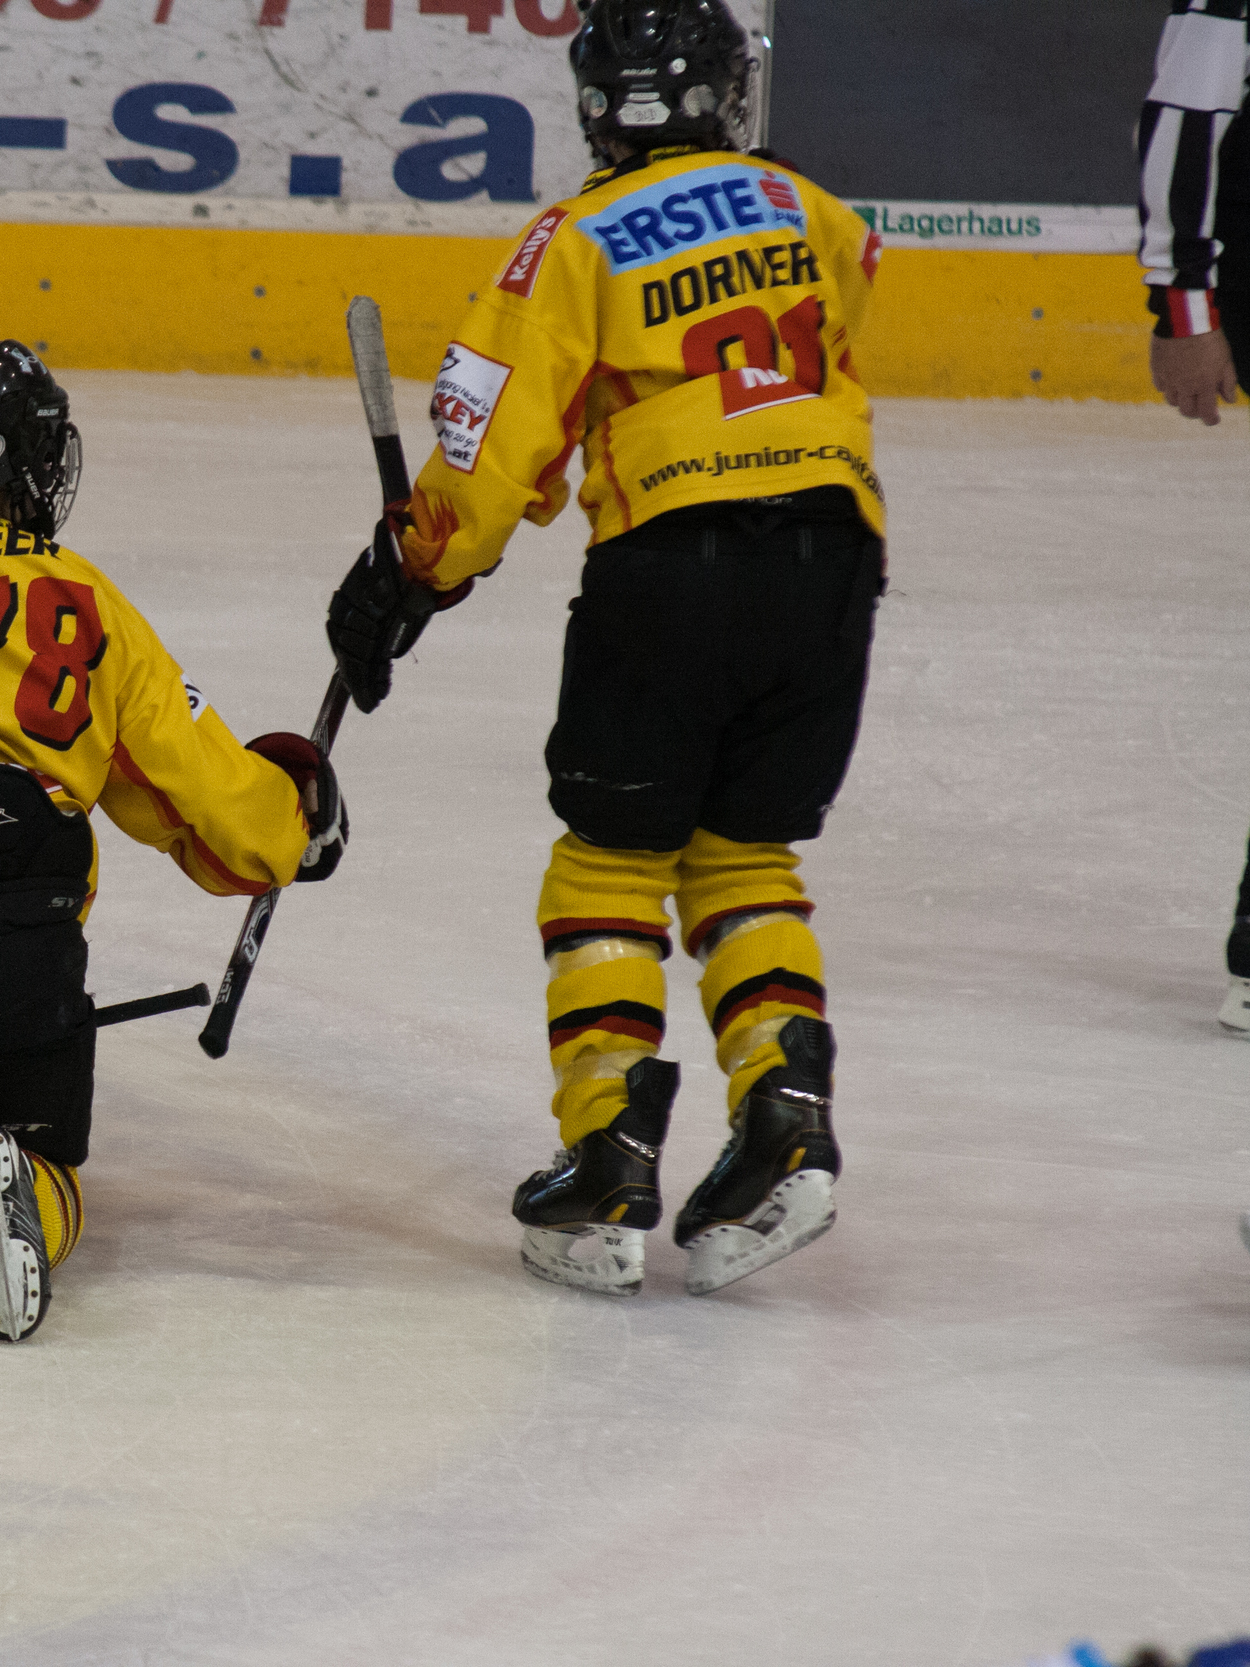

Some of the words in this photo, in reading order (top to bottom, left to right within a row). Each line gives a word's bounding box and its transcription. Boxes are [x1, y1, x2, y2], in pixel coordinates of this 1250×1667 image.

[507, 215, 556, 282] Kelly's
[595, 178, 766, 265] ERSTE
[882, 206, 1041, 239] Lagerhaus
[641, 240, 822, 329] DORNER
